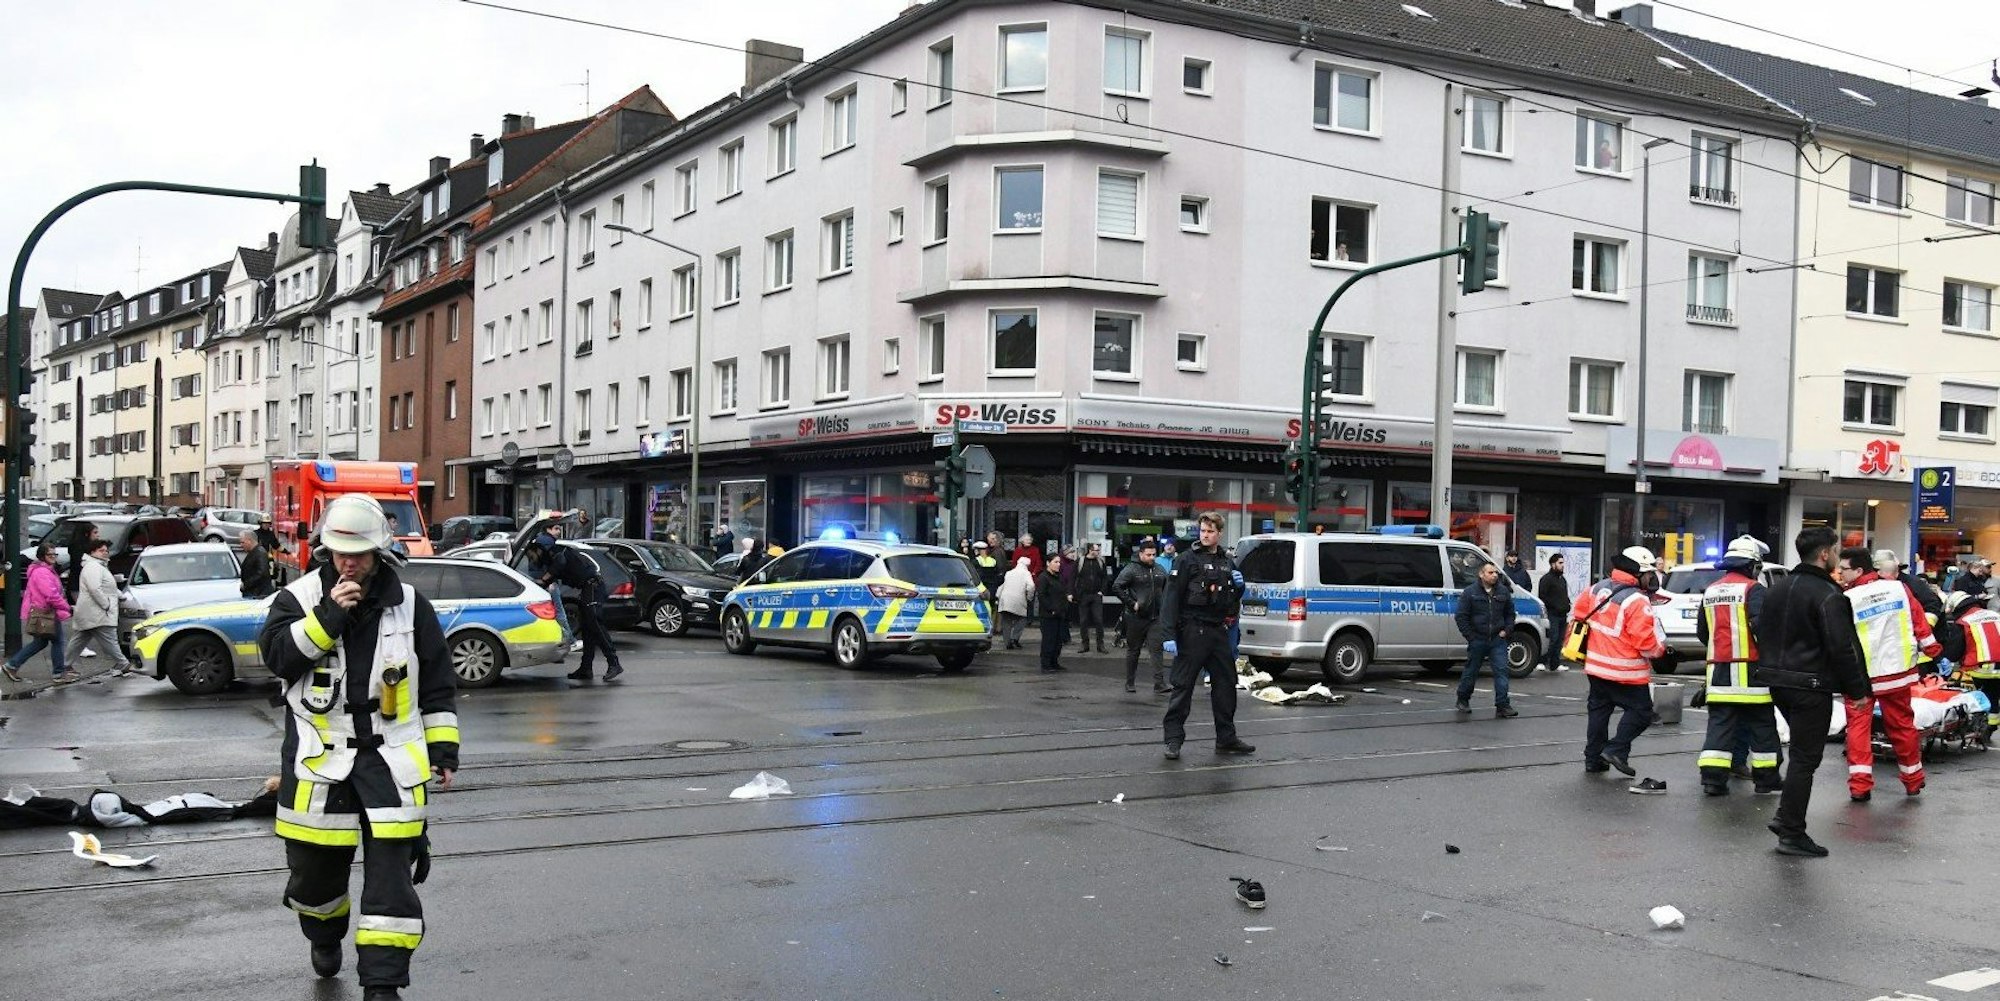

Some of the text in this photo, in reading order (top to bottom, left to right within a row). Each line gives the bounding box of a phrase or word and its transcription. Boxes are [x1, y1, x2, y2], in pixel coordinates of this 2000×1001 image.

[937, 404, 1057, 425] SP:Weiss
[798, 415, 849, 437] SP:Weiss
[1077, 417, 1109, 427] SONY
[1117, 420, 1150, 430] Technics
[1286, 418, 1387, 443] SWeiss
[1942, 471, 1950, 487] 2
[757, 595, 782, 606] POLIZEI
[1257, 588, 1290, 600] POLIZEI
[1390, 600, 1436, 613] POLIZEI
